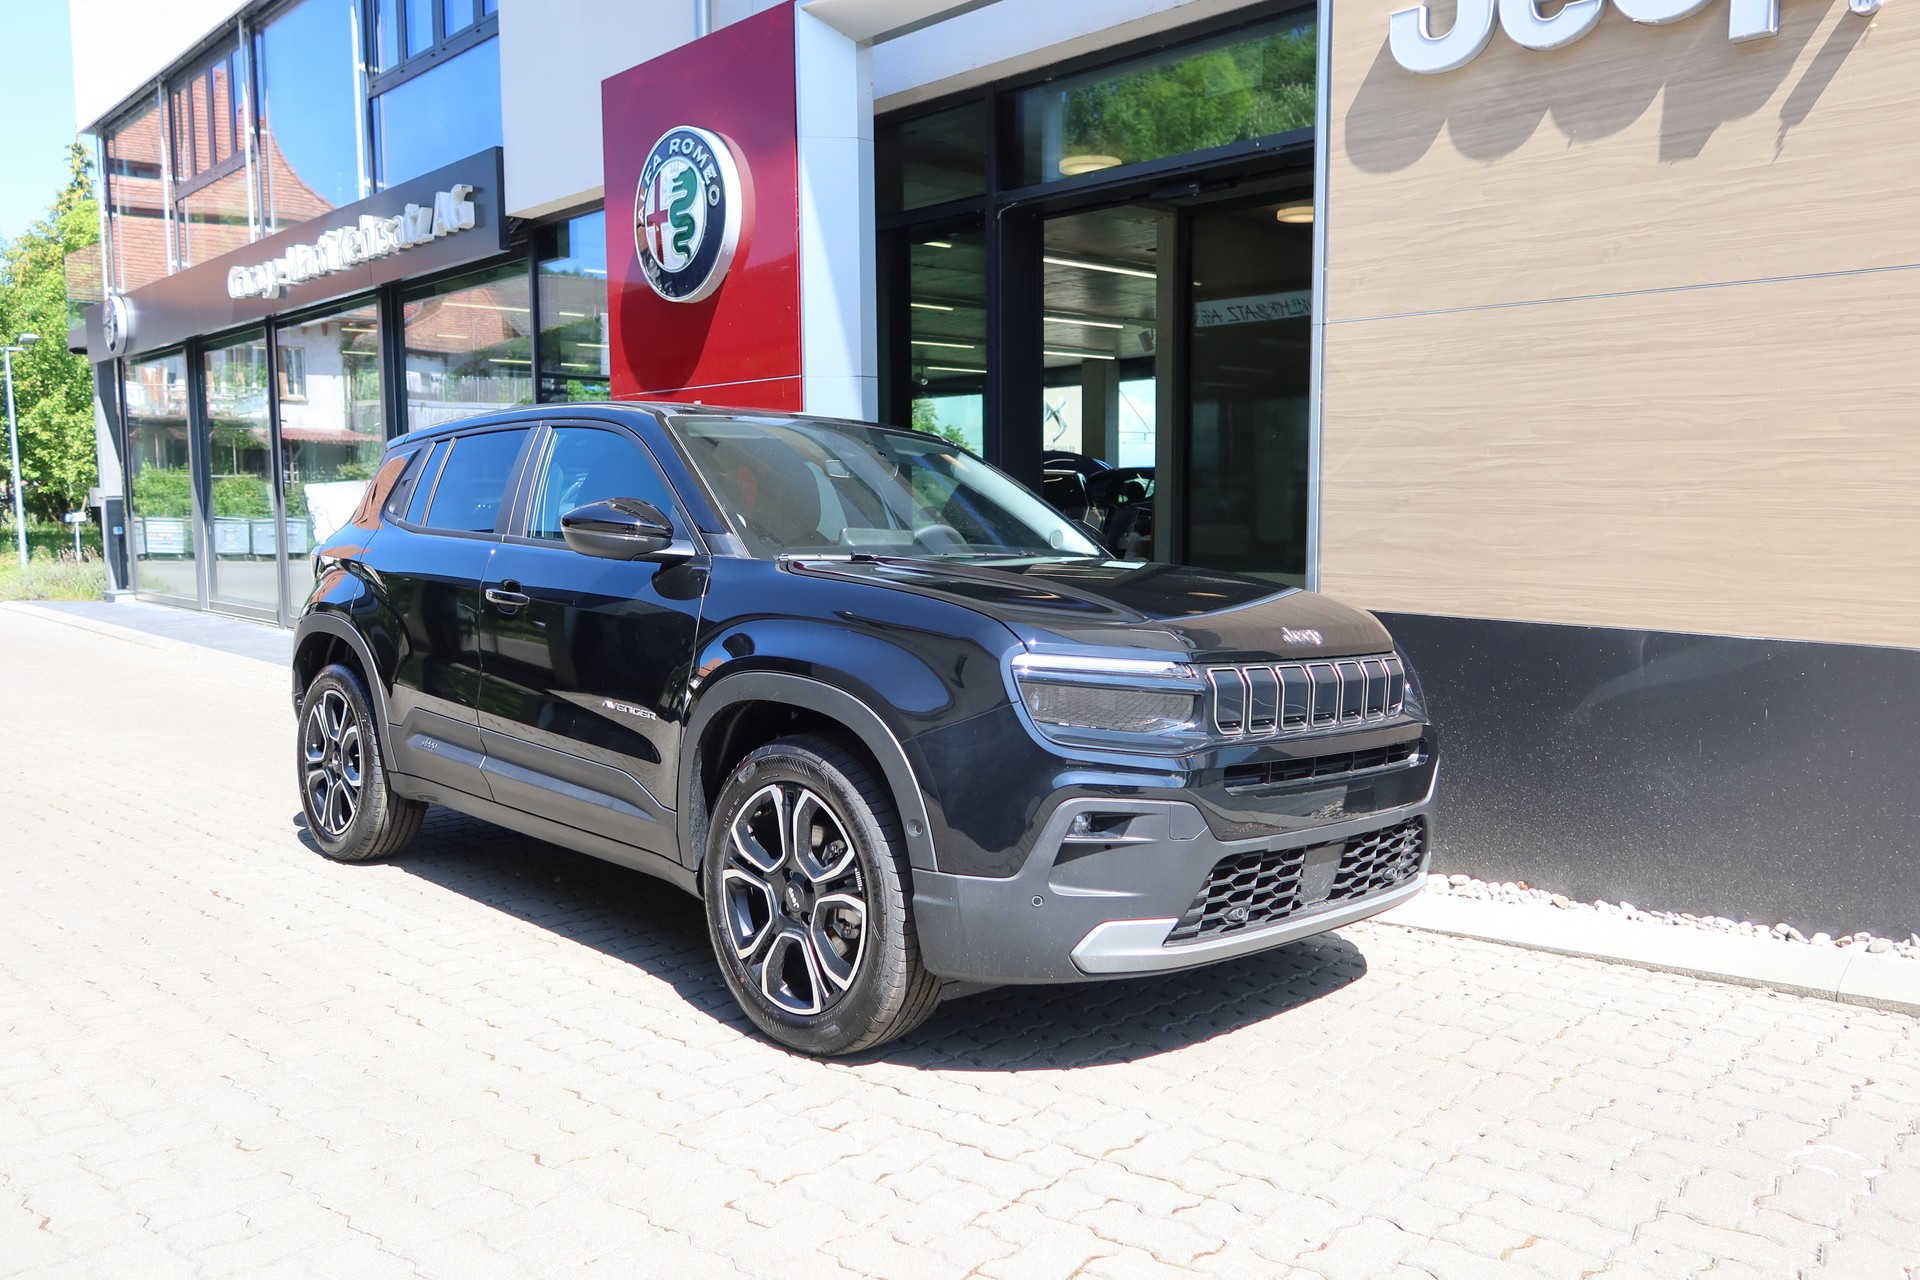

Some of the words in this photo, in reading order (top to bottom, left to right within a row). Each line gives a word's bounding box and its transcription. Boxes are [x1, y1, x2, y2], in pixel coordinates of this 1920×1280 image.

[637, 154, 663, 223] ALFA
[668, 137, 720, 207] ROMEO
[432, 183, 475, 236] AG
[1281, 626, 1323, 645] Jeep
[602, 700, 657, 720] AVENGER
